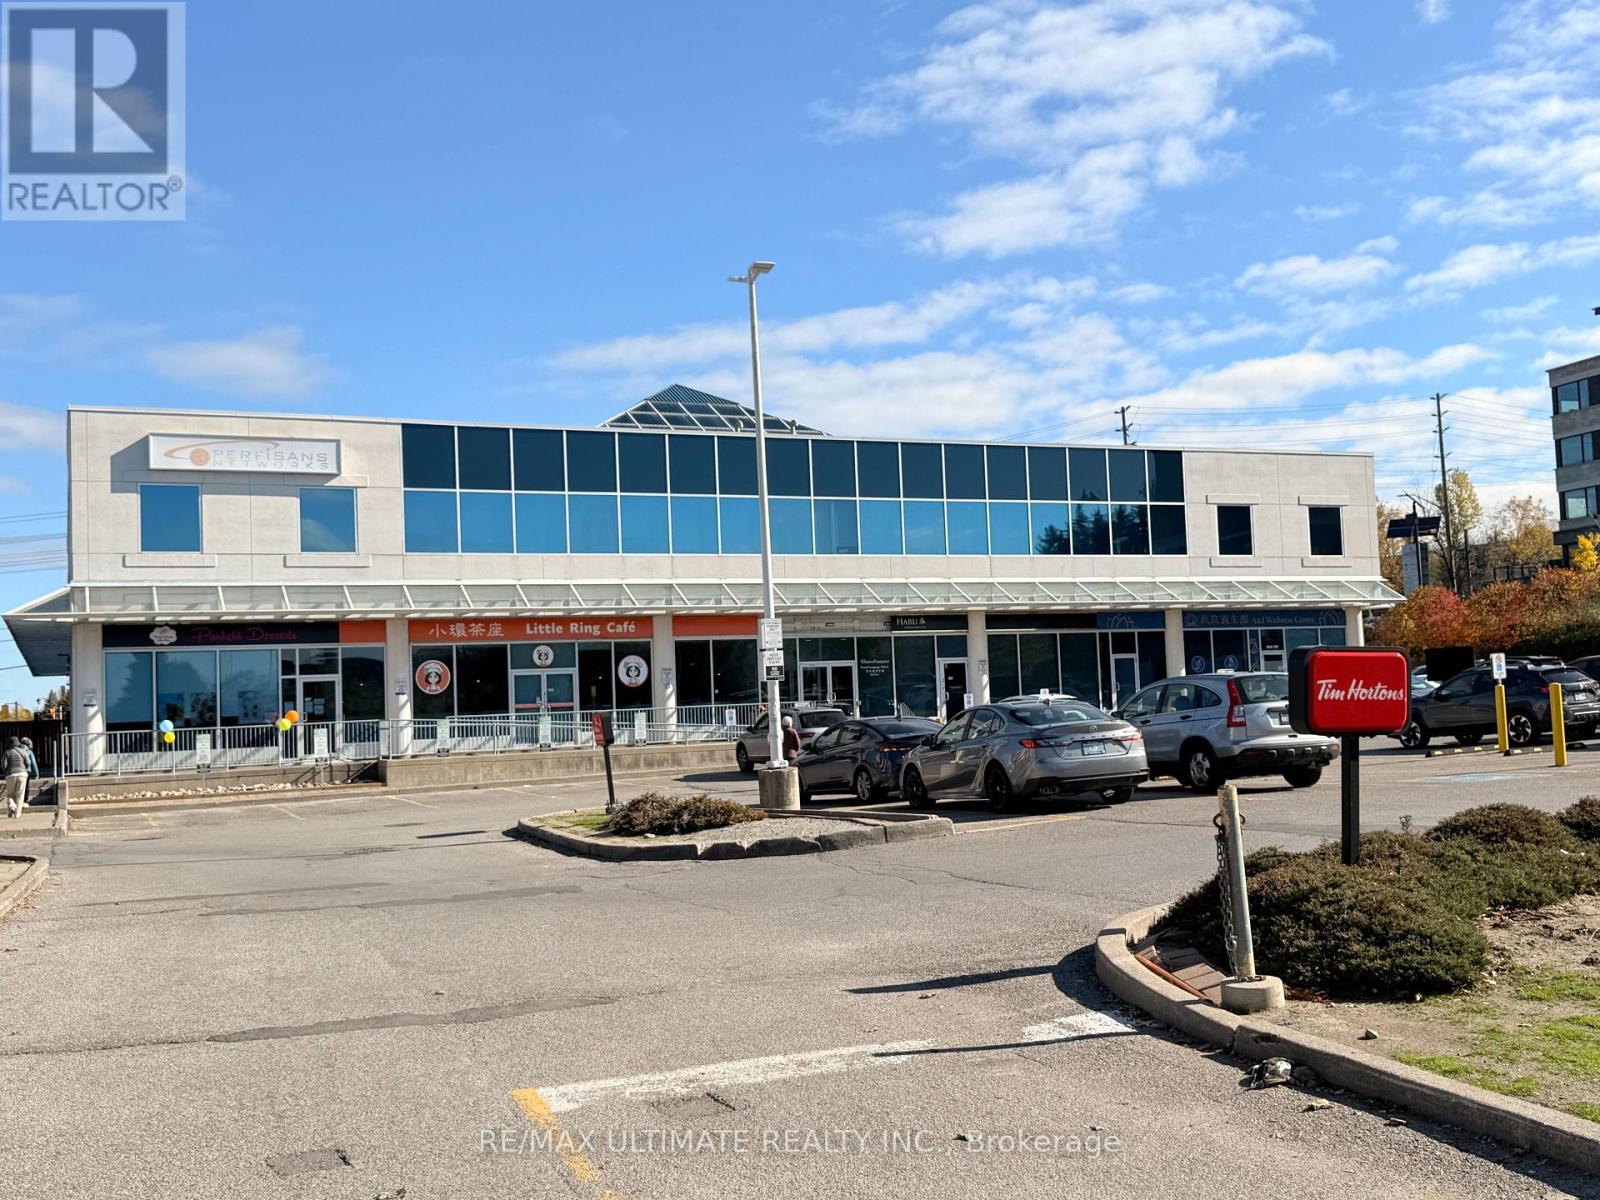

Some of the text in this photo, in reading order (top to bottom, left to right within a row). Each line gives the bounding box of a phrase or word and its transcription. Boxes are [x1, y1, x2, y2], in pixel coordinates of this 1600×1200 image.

[213, 448, 328, 462] PERFISANS
[429, 622, 504, 638] 小環茶座
[526, 621, 636, 636] Little Ring Café
[1317, 678, 1404, 700] Tim Hortons
